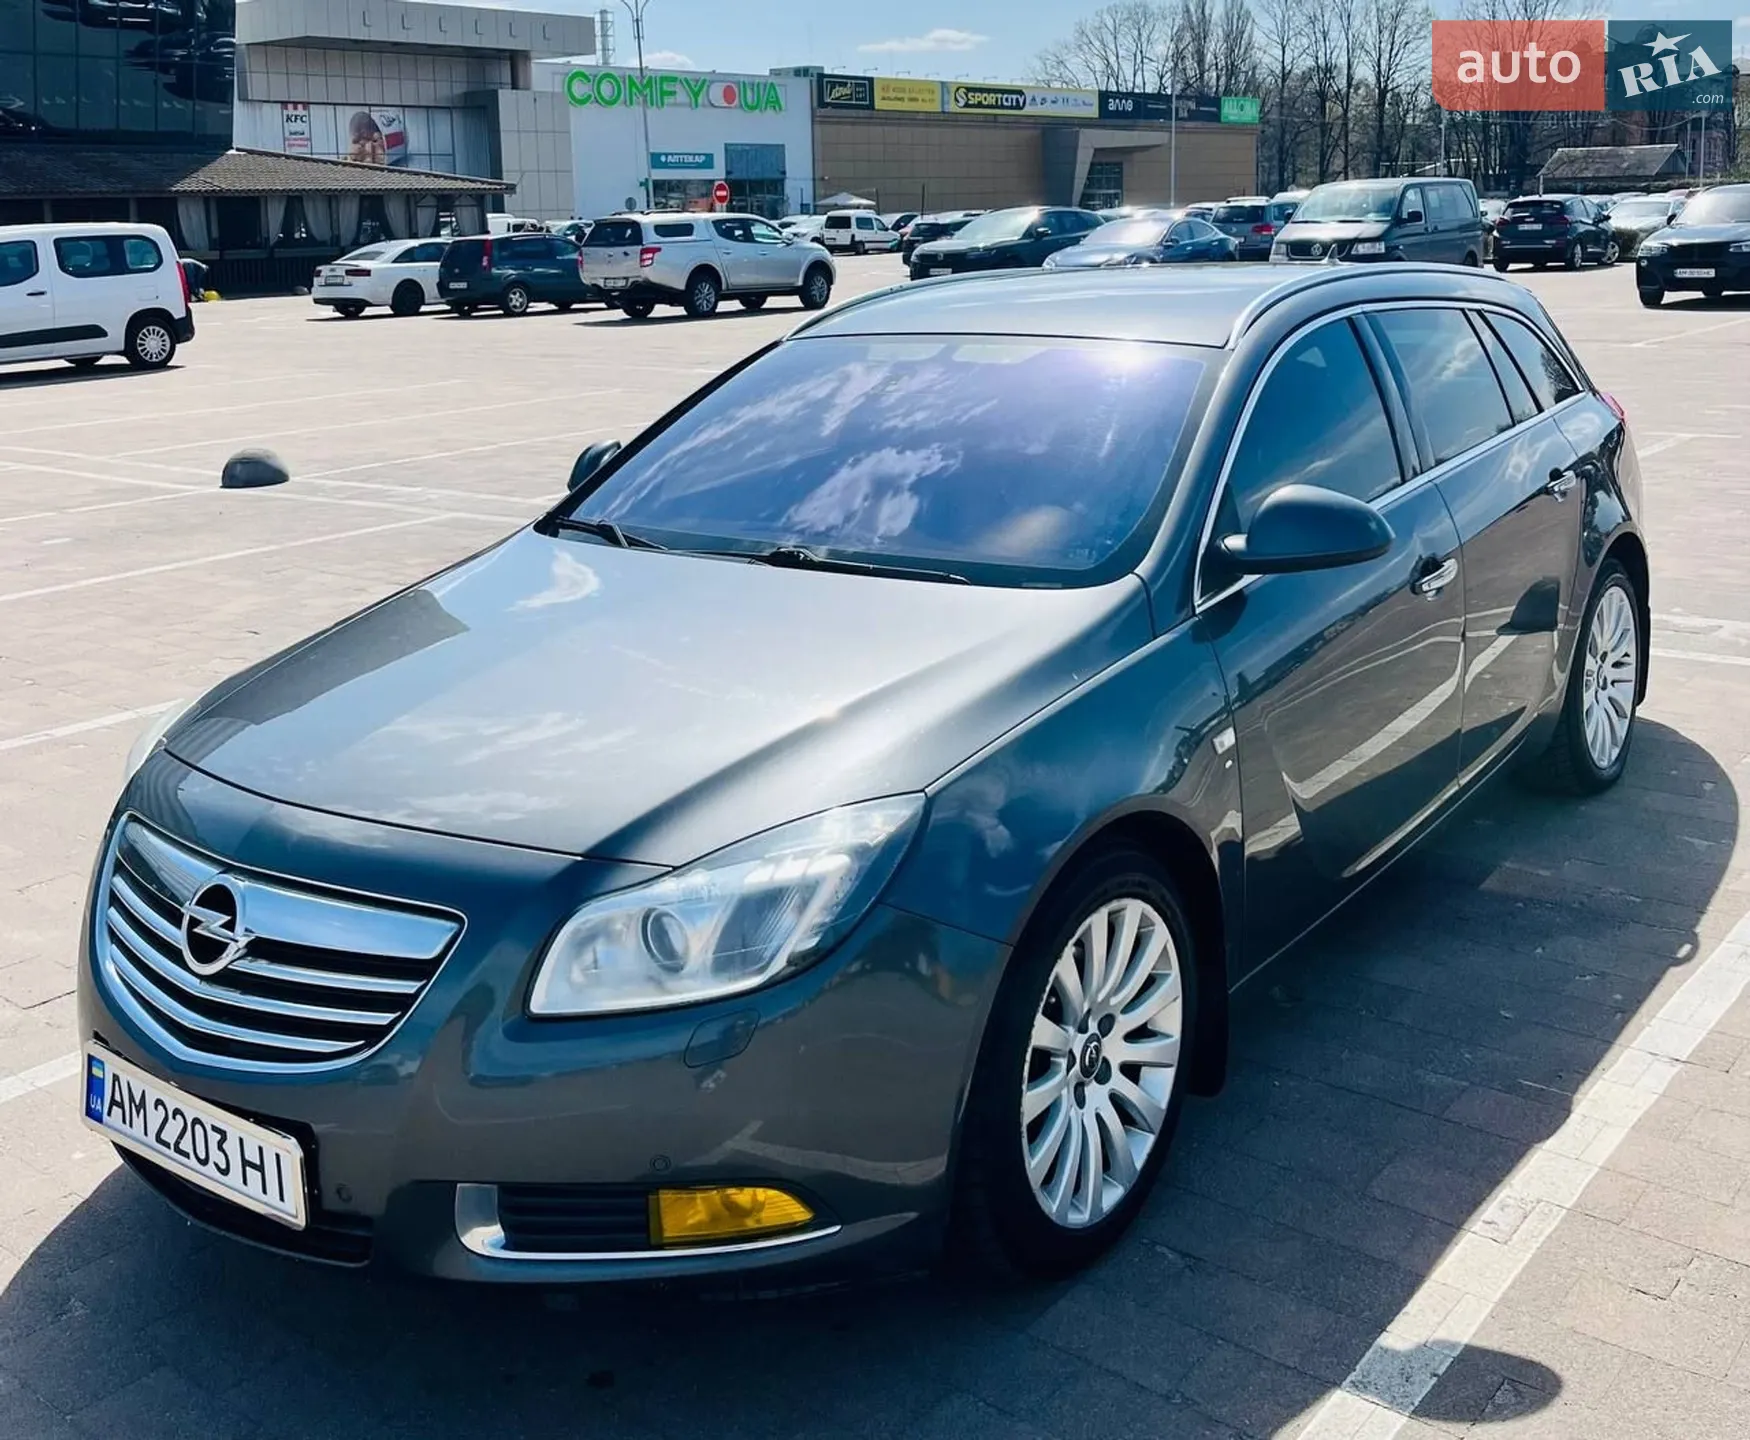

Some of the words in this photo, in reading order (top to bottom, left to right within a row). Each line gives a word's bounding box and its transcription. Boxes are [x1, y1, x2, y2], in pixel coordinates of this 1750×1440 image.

[565, 69, 708, 108] COMFY
[740, 80, 784, 113] UA
[967, 92, 1025, 108] SPORTCITY
[285, 114, 307, 124] KFC
[90, 1093, 102, 1112] UA
